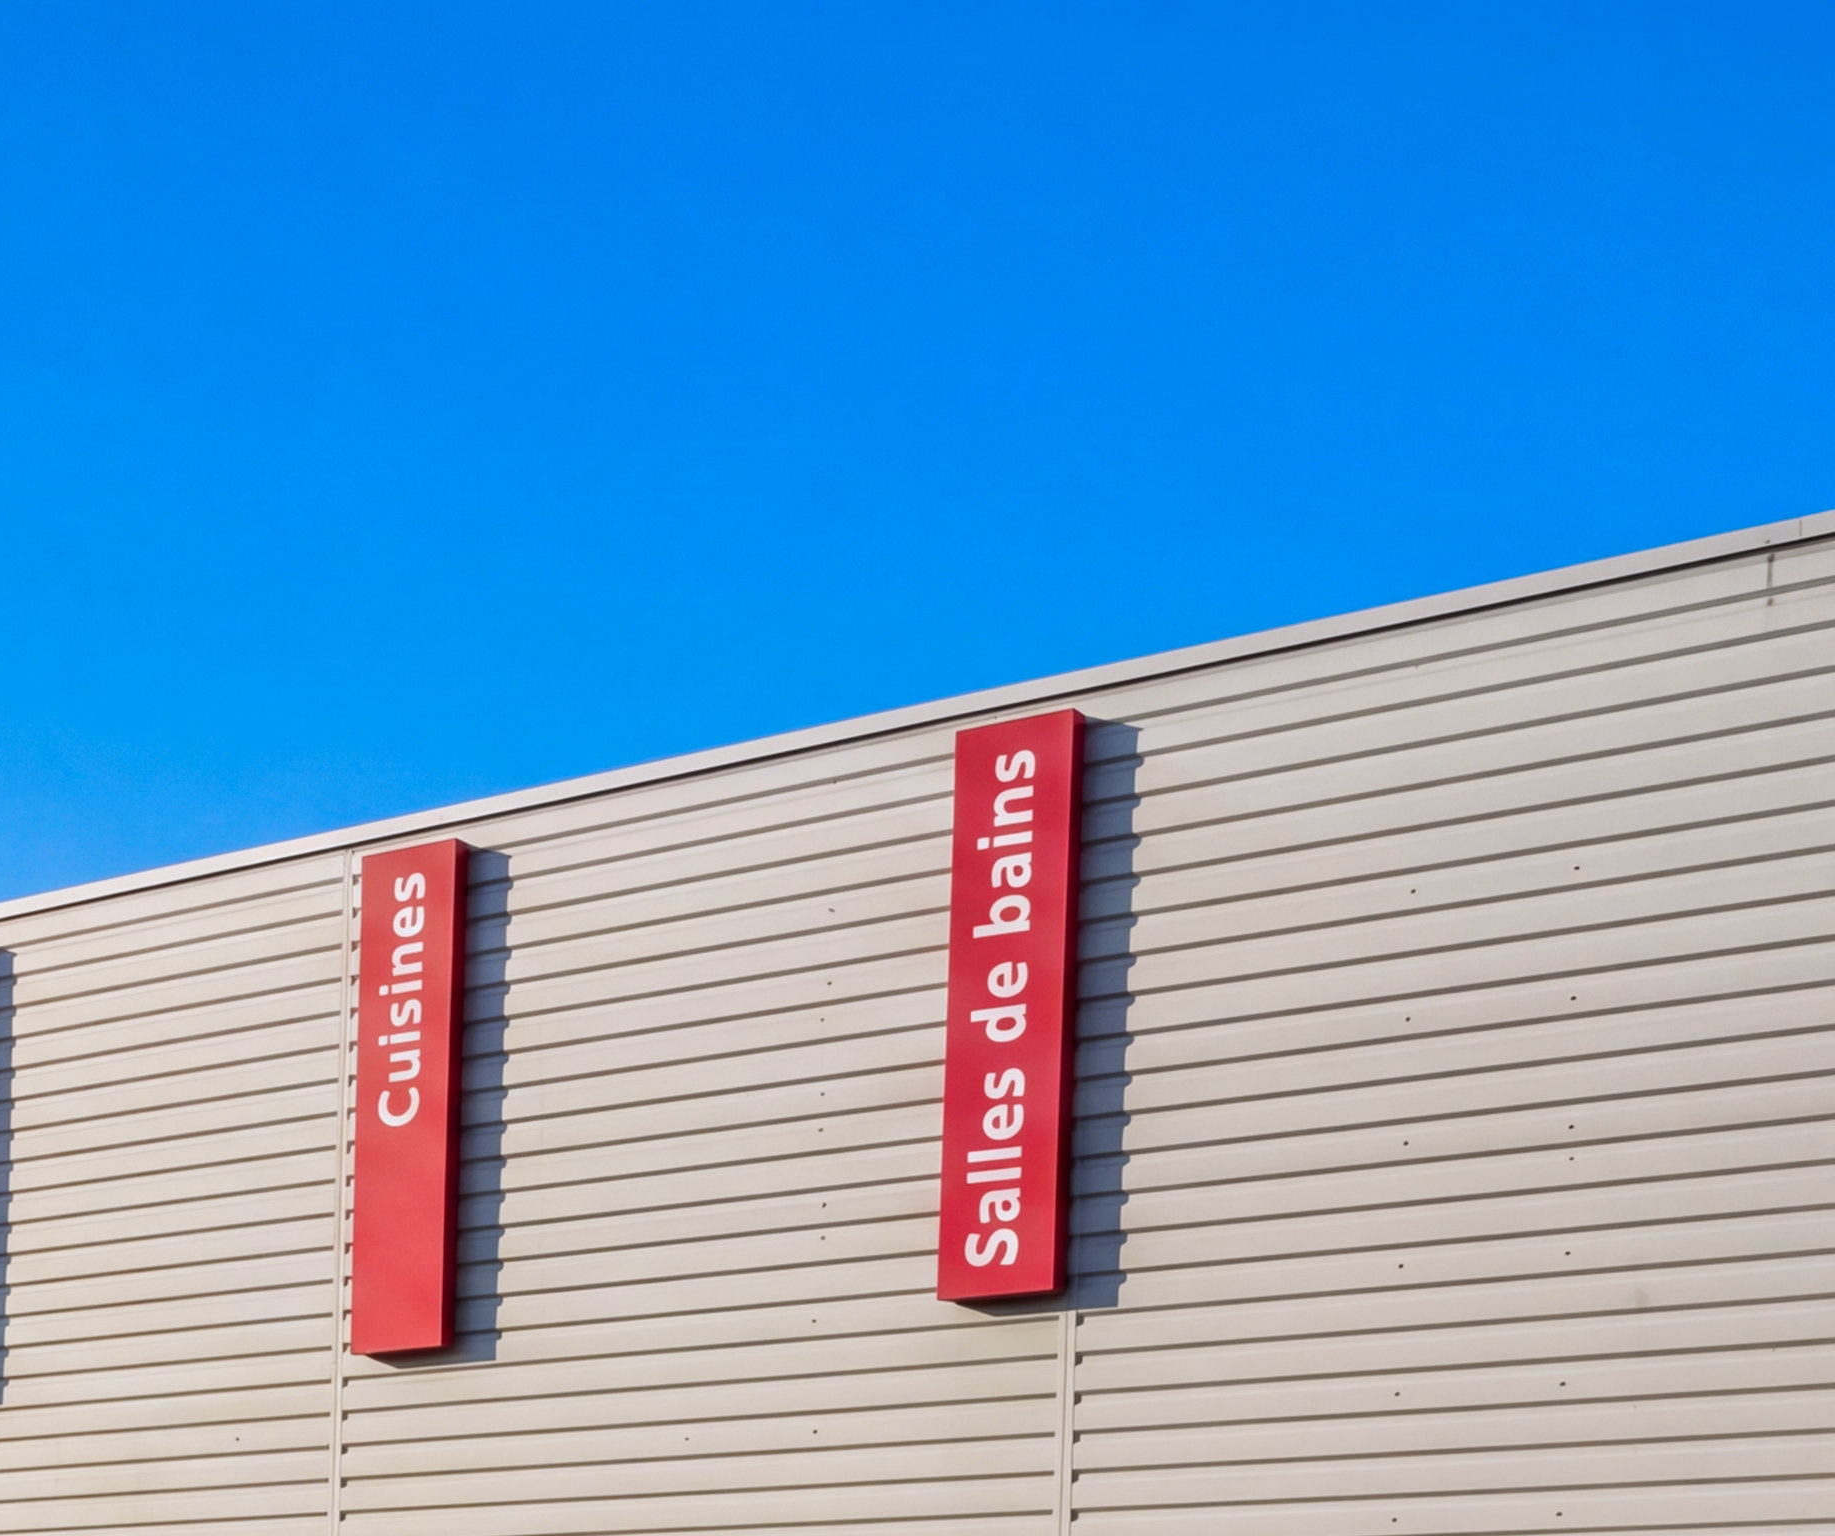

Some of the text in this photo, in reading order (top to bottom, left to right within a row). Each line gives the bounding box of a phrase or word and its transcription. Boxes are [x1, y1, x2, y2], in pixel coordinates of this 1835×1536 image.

[378, 871, 426, 1127] Cuisines
[964, 748, 1035, 1267] Salles de bains
